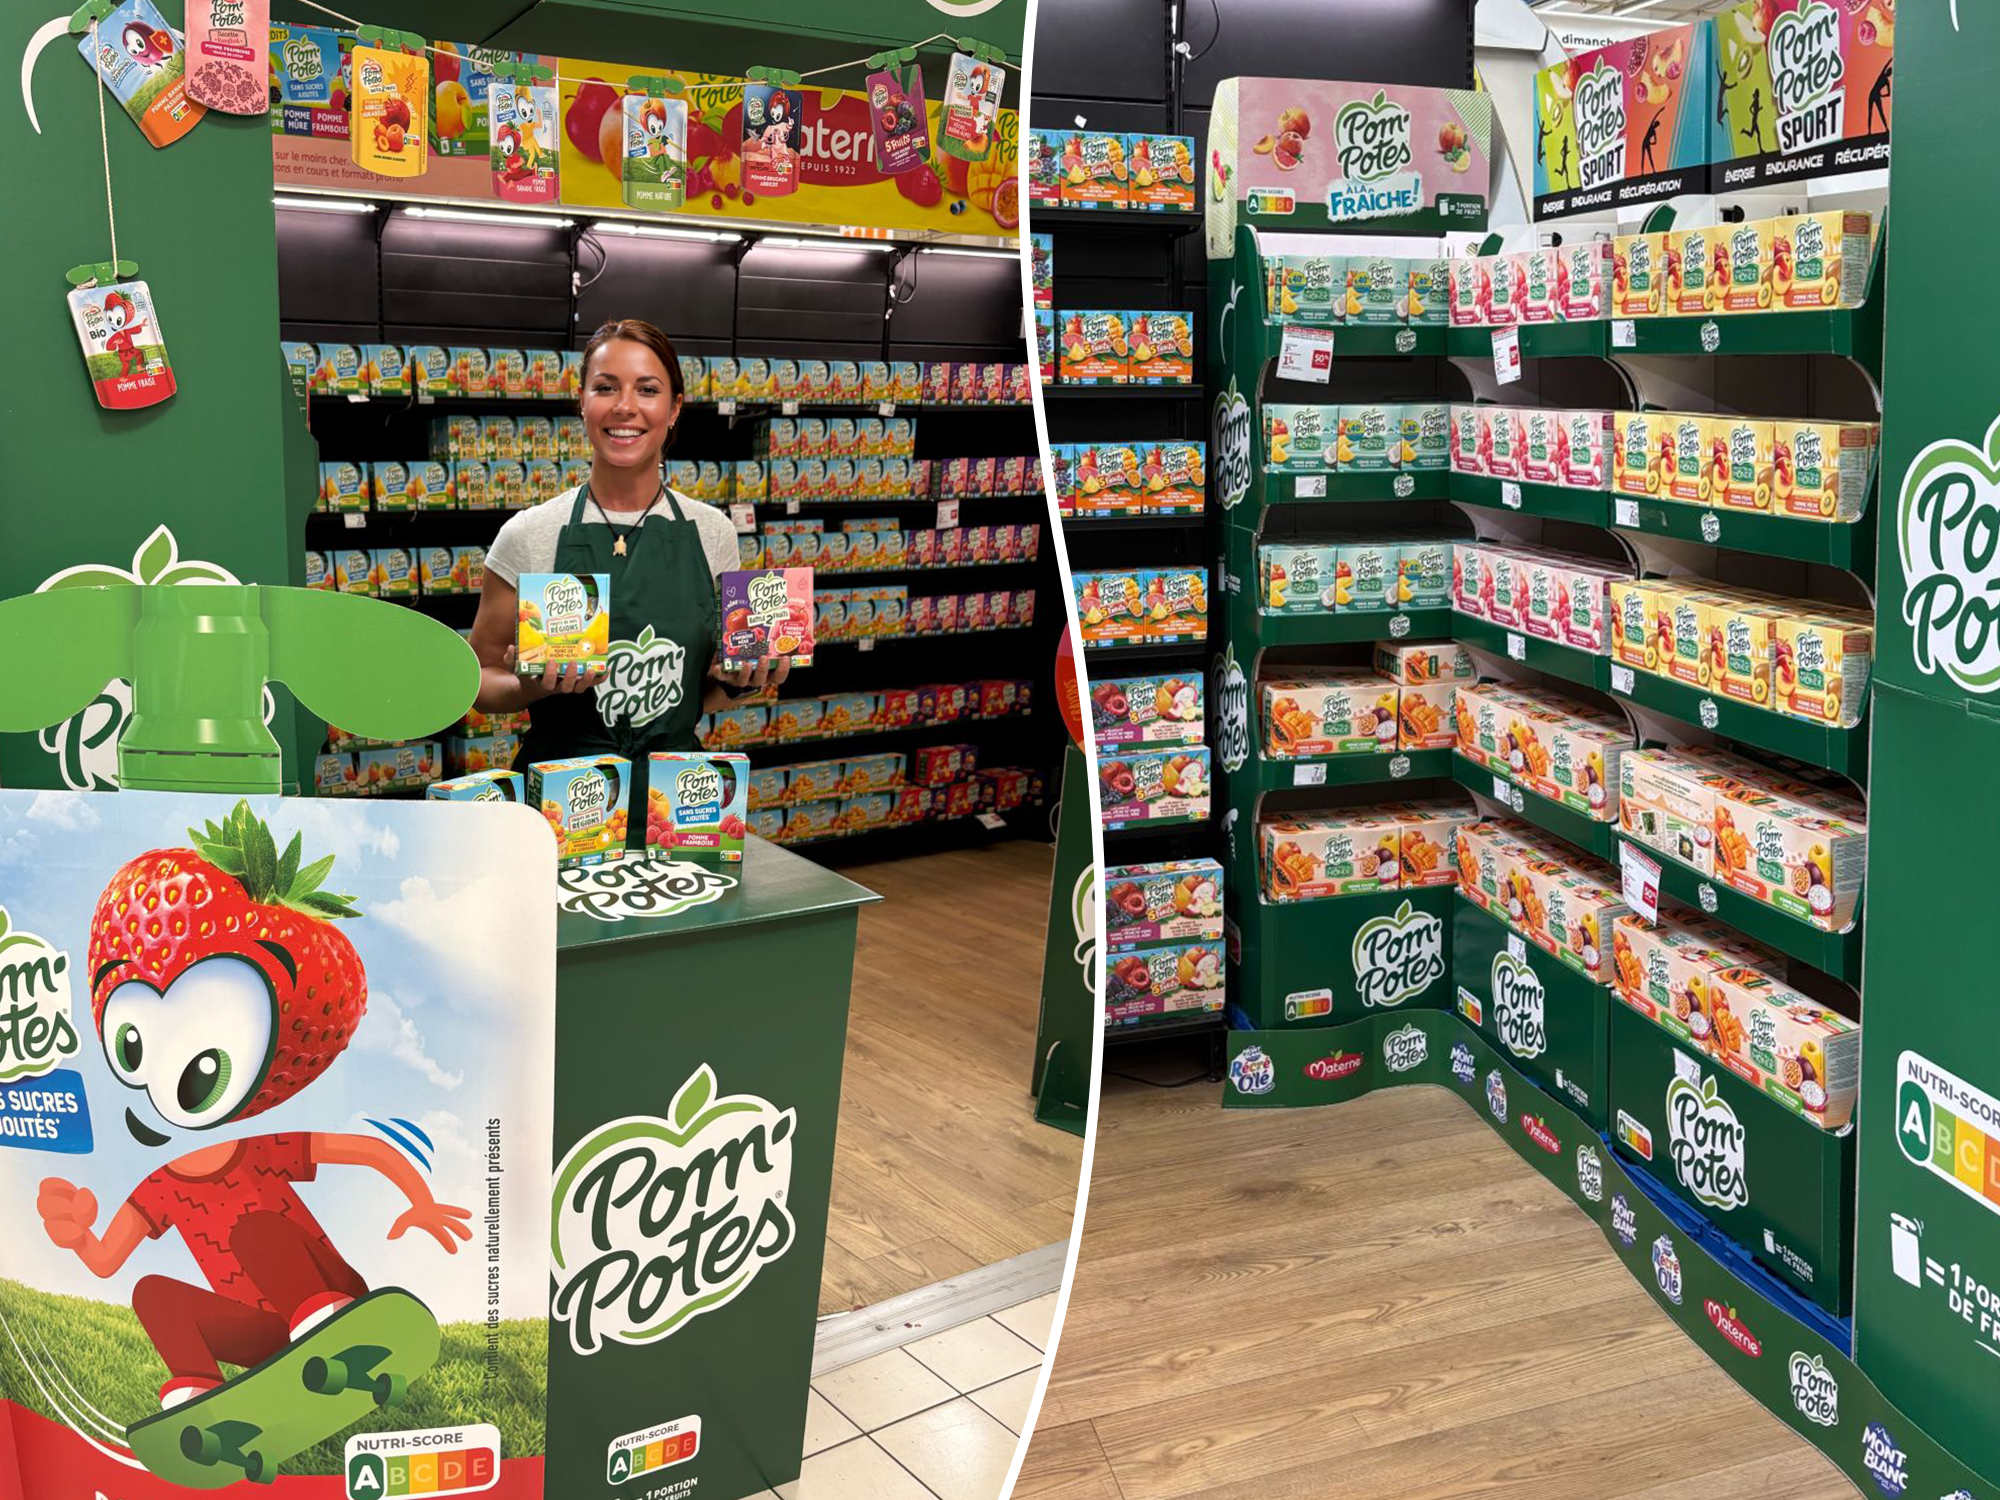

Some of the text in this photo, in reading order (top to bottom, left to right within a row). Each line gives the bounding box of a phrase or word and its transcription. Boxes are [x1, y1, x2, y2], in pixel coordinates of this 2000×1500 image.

[210, 13, 244, 27] Potes
[287, 62, 323, 79] Potes
[1775, 51, 1843, 109] Potes
[305, 83, 324, 91] SUCRES
[284, 109, 311, 120] POMME
[287, 118, 309, 130] MÛRE
[317, 112, 343, 123] POMME
[1781, 96, 1842, 151] SPORT
[312, 123, 349, 135] FRAMBOISE
[1578, 107, 1626, 154] Potes
[275, 152, 289, 160] sur
[291, 151, 299, 160] le
[301, 153, 326, 163] moins
[1338, 139, 1411, 180] Potes
[1582, 148, 1624, 188] SPORT
[1765, 154, 1824, 176] ENDURANCE
[293, 166, 374, 180] en cours et formats
[834, 165, 856, 176] 1922
[636, 191, 653, 201] POMME
[1796, 240, 1824, 260] Potes
[117, 378, 157, 392] POMME FRAISE
[1795, 449, 1822, 470] Potes
[1917, 471, 2000, 574] Po
[546, 597, 583, 617] Potes
[751, 593, 788, 613] Potes
[550, 624, 579, 634] RÉGIONS
[765, 614, 773, 625] 2
[1797, 650, 1825, 670] Potes
[601, 677, 682, 726] Potes
[1213, 713, 1247, 767] Potes
[569, 791, 605, 813] Potes
[678, 786, 718, 805] Potes
[695, 806, 717, 814] SUCRES
[571, 817, 600, 830] RÉGIONS
[564, 871, 733, 920] Potes
[1357, 950, 1443, 1002] Potes
[1494, 1003, 1546, 1052] Potes
[1231, 1057, 1270, 1078] Récré
[1386, 1046, 1428, 1072] Potes
[1450, 1047, 1475, 1064] MONT
[1309, 1057, 1362, 1079] Materne
[1452, 1060, 1477, 1080] BLANC
[10, 1090, 78, 1114] SUCRES
[1908, 1059, 2000, 1128] NUTRI-SCOR
[485, 1117, 504, 1173] présents
[1523, 1115, 1559, 1153] Materne
[1902, 1099, 1927, 1146] A
[1937, 1121, 1951, 1156] B
[1959, 1138, 1979, 1173] C
[1669, 1137, 1748, 1203] Potes
[484, 1176, 501, 1262] naturellement
[1610, 1196, 1636, 1224] MONT
[1612, 1212, 1637, 1241] BLANC
[1652, 1245, 1681, 1274] Récré
[1787, 1250, 1814, 1275] PORTION
[1792, 1260, 1814, 1283] FRUITS
[557, 1195, 790, 1351] Potes
[1950, 1262, 1960, 1288] 1
[488, 1265, 500, 1306] sucres
[1949, 1288, 1974, 1324] DE
[485, 1308, 499, 1330] des
[1707, 1301, 1759, 1356] Materne
[1793, 1383, 1838, 1424] Potes
[356, 1432, 464, 1452] NUTRI-SCORE
[615, 1423, 680, 1449] NUTRI-SCORE
[1862, 1425, 1907, 1467] MONT
[611, 1437, 693, 1476] A B C D E
[353, 1456, 488, 1492] A B C D E
[1863, 1450, 1909, 1491] BLANC
[646, 1476, 699, 1500] 1 PORTION
